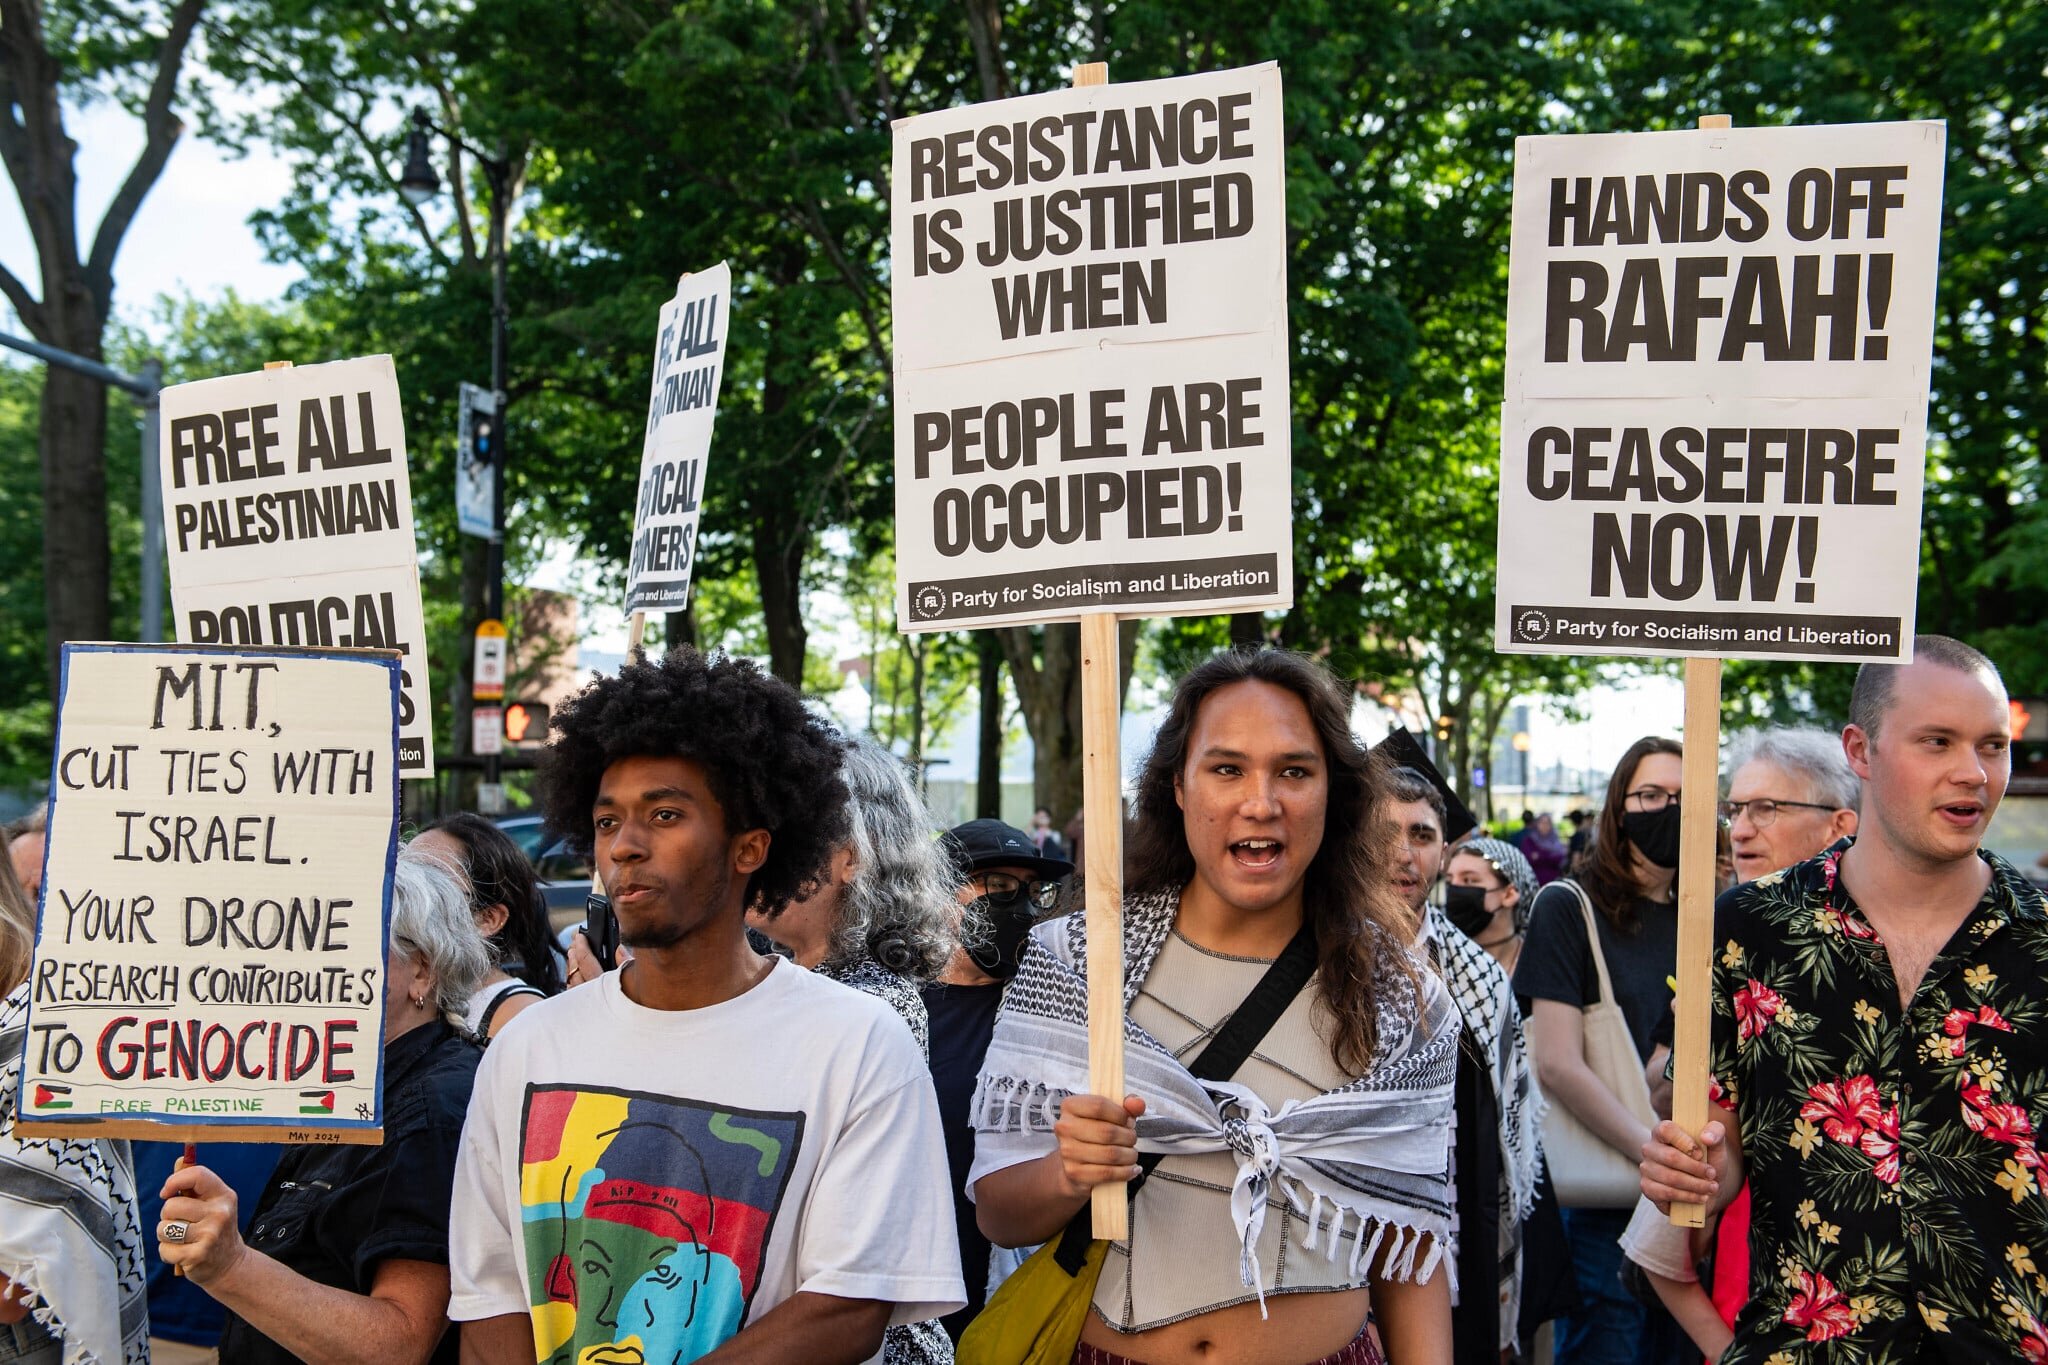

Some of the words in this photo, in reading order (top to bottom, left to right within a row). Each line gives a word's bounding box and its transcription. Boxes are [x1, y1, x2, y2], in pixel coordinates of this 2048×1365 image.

[911, 93, 1253, 202] RESISTANCE
[913, 208, 963, 276] IS
[977, 172, 1253, 267] JUSTIFIED
[1547, 170, 1770, 247] HANDS
[1787, 166, 1908, 241] OFF
[675, 294, 718, 362] ALL
[992, 258, 1167, 340] WHEN
[1544, 253, 1894, 362] RAFAH!
[171, 403, 285, 489] FREE
[298, 391, 392, 473] ALL
[914, 389, 1127, 479] PEOPLE
[1142, 377, 1264, 456] ARE
[1527, 426, 1899, 505] CEASEFIRE
[175, 479, 399, 552] PALESTINIAN
[933, 462, 1243, 557] OCCUPIED!
[952, 591, 998, 609] Party
[1002, 587, 1027, 602] for
[1032, 578, 1122, 599] Socialism
[1128, 575, 1164, 592] and
[1172, 568, 1269, 590] Liberation
[1590, 512, 1818, 603] NOW!
[1556, 619, 1605, 639] Party
[1611, 621, 1639, 637] for
[1644, 622, 1738, 641] Socialism
[1744, 625, 1781, 642] and
[1788, 626, 1892, 646] Liberation
[60, 745, 139, 791] CUT
[160, 750, 248, 795] TIES
[273, 750, 374, 795] WITH
[114, 811, 310, 865] ISRAEL.
[59, 889, 157, 945] YOUR
[184, 896, 353, 952] DRONE
[35, 958, 179, 1003] RESEARCH
[189, 962, 376, 1006] CONTRIBUTES
[32, 1023, 83, 1074] TO
[96, 1016, 358, 1084] GENOCIDE
[100, 1099, 152, 1113] FREE
[165, 1098, 264, 1112] PALESTINE
[289, 1132, 309, 1141] MAY
[315, 1133, 340, 1142] 2024
